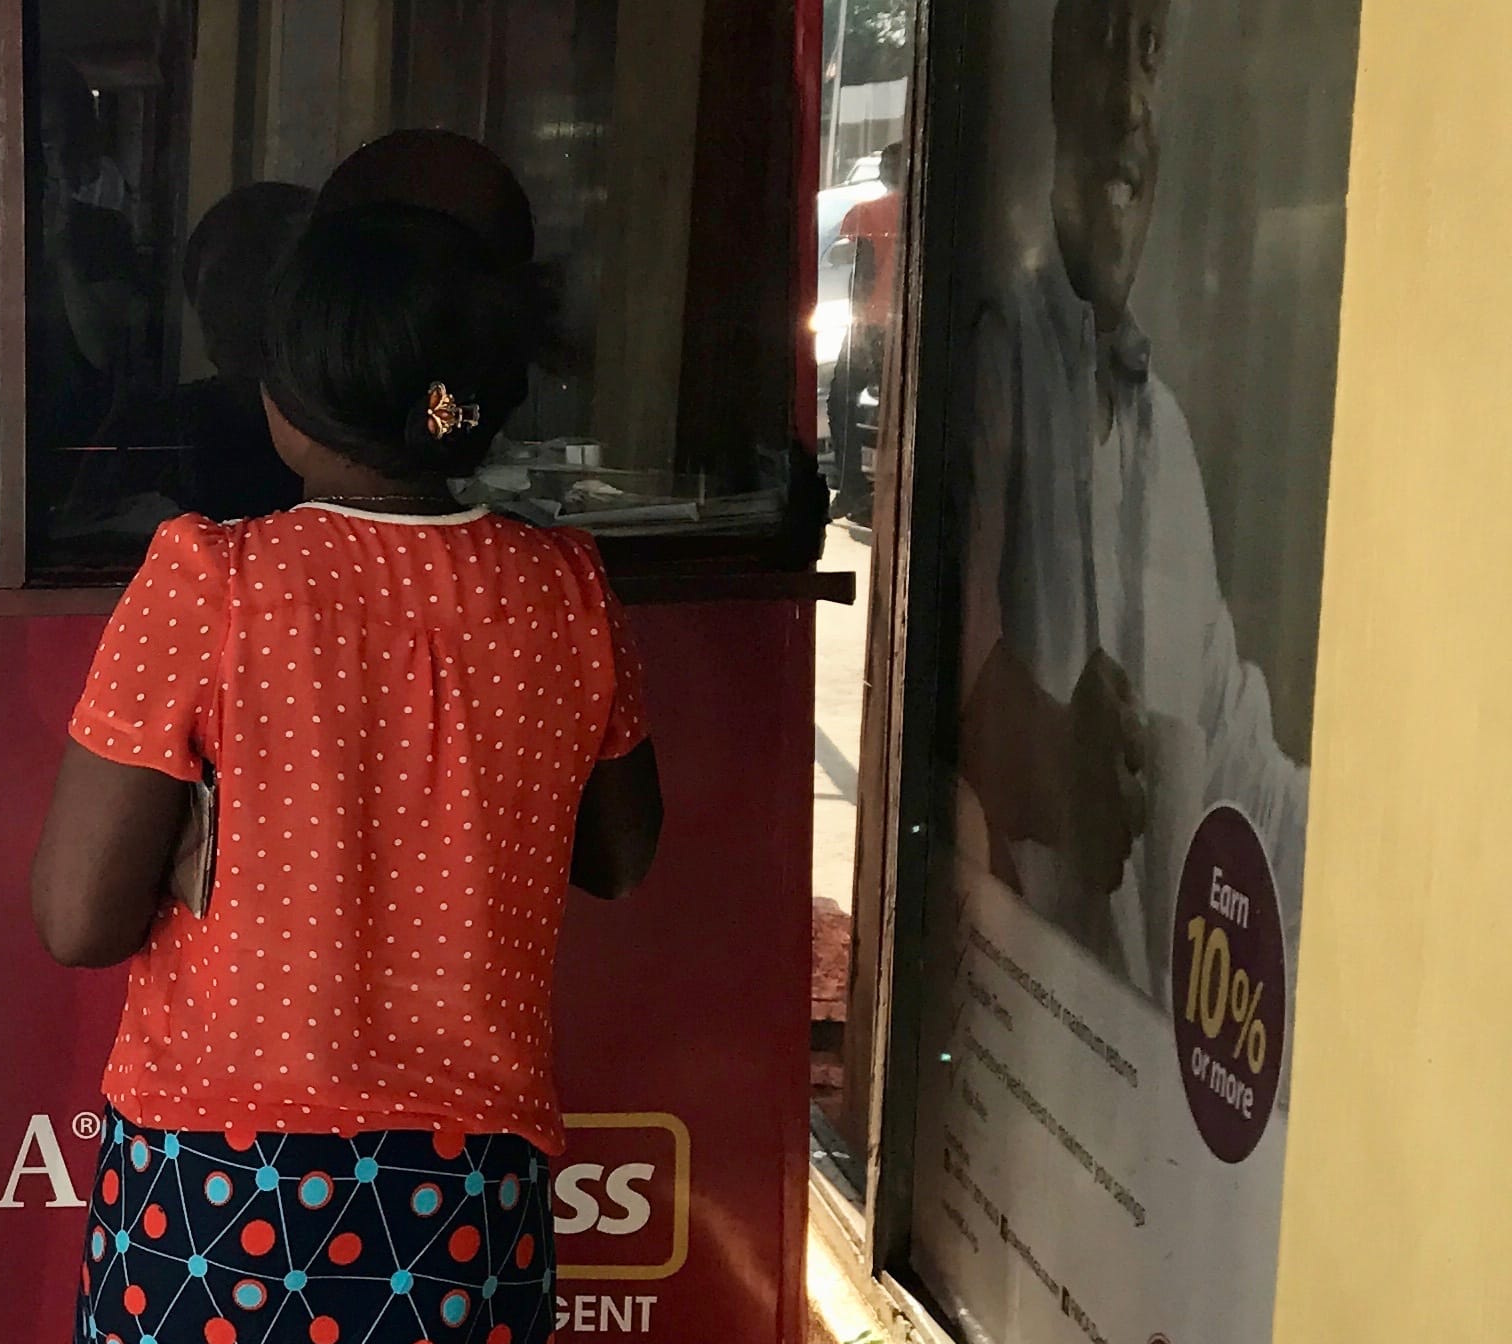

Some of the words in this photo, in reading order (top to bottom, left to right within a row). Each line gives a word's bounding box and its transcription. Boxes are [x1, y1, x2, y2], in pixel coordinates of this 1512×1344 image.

[1210, 865, 1250, 928] Earn
[1185, 915, 1266, 1075] 10%
[1191, 1046, 1207, 1083] or
[1210, 1058, 1255, 1120] more
[554, 1162, 656, 1234] ss
